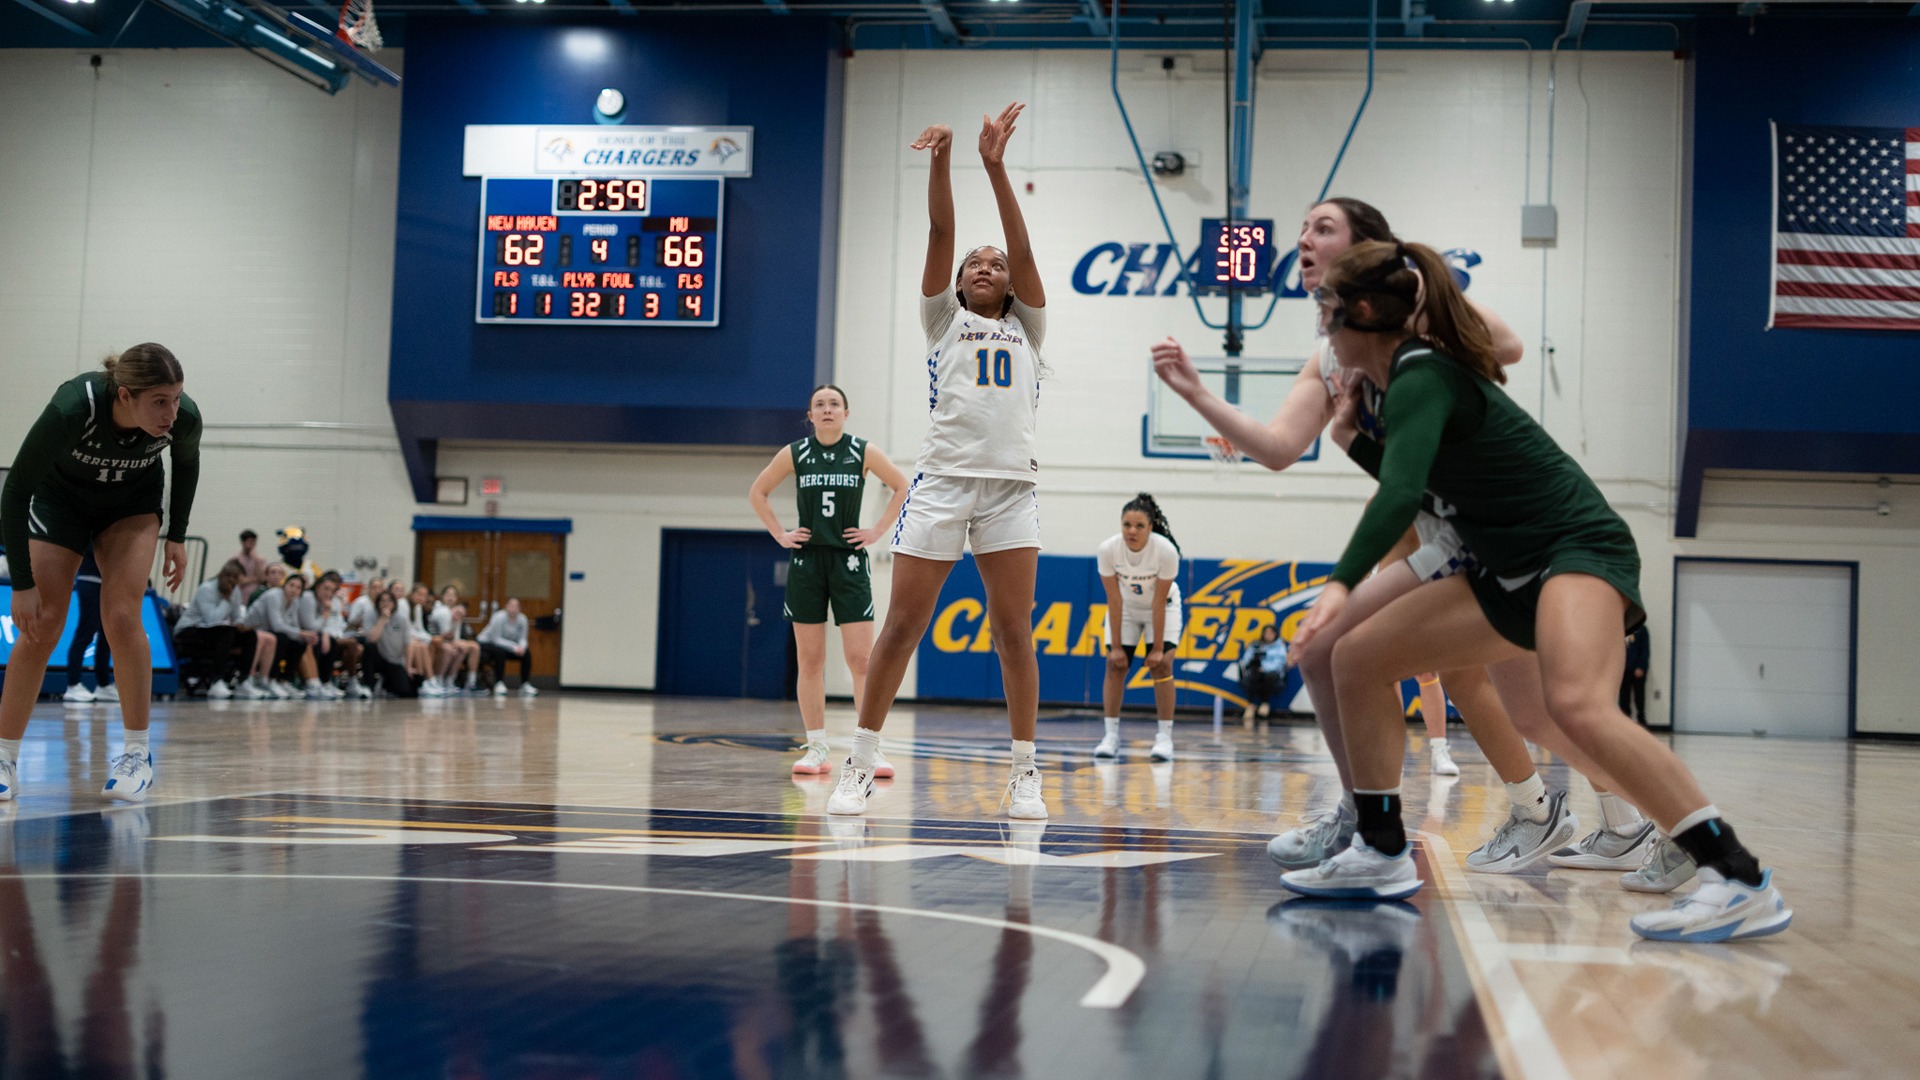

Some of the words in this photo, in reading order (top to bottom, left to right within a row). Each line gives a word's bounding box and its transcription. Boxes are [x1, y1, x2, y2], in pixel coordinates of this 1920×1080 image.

[583, 148, 700, 167] CHARGERS
[578, 179, 646, 211] 2:59
[487, 215, 514, 231] NEW
[516, 216, 557, 231] HAVEN
[583, 224, 618, 236] PERIOD
[669, 217, 689, 232] MU
[503, 234, 544, 266] 62
[591, 239, 608, 262] 4
[663, 235, 704, 267] 66
[493, 271, 520, 287] FLS
[563, 272, 596, 288] PLYR
[602, 272, 635, 289] FOUL
[677, 273, 703, 289] FLS
[570, 292, 601, 317] 32
[645, 293, 660, 318] 3
[685, 294, 702, 317] 4
[957, 331, 989, 343] NEW
[975, 347, 1013, 389] 10
[96, 468, 126, 483] 11
[799, 474, 860, 488] MERCYHURST
[821, 491, 836, 518] 5
[1130, 583, 1144, 596] 3
